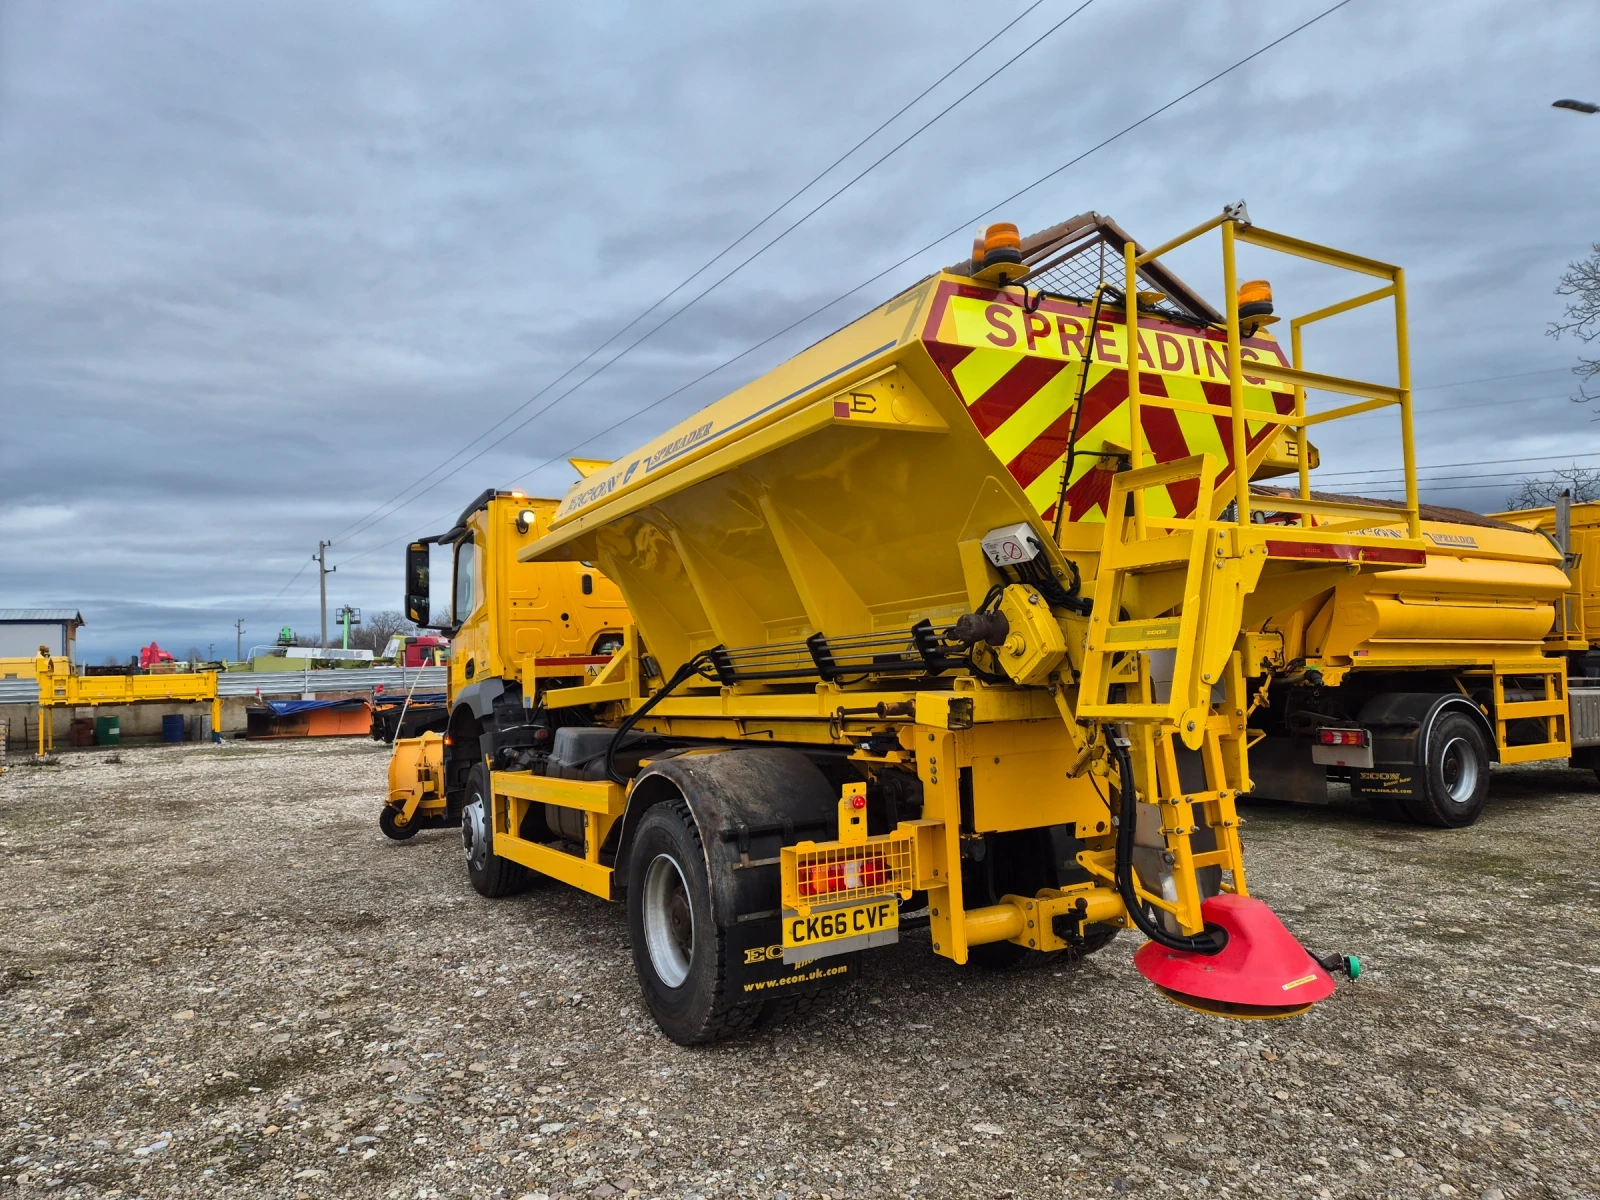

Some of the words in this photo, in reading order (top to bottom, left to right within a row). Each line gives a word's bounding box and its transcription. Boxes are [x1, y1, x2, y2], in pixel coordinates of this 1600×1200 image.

[651, 421, 713, 465] SPREADER
[1432, 532, 1477, 545] SPREADER
[1360, 772, 1401, 780] ECON
[792, 913, 847, 943] CK66
[853, 904, 890, 931] CVF
[744, 944, 784, 964] EC
[743, 965, 848, 992] www.econ.uk.com
